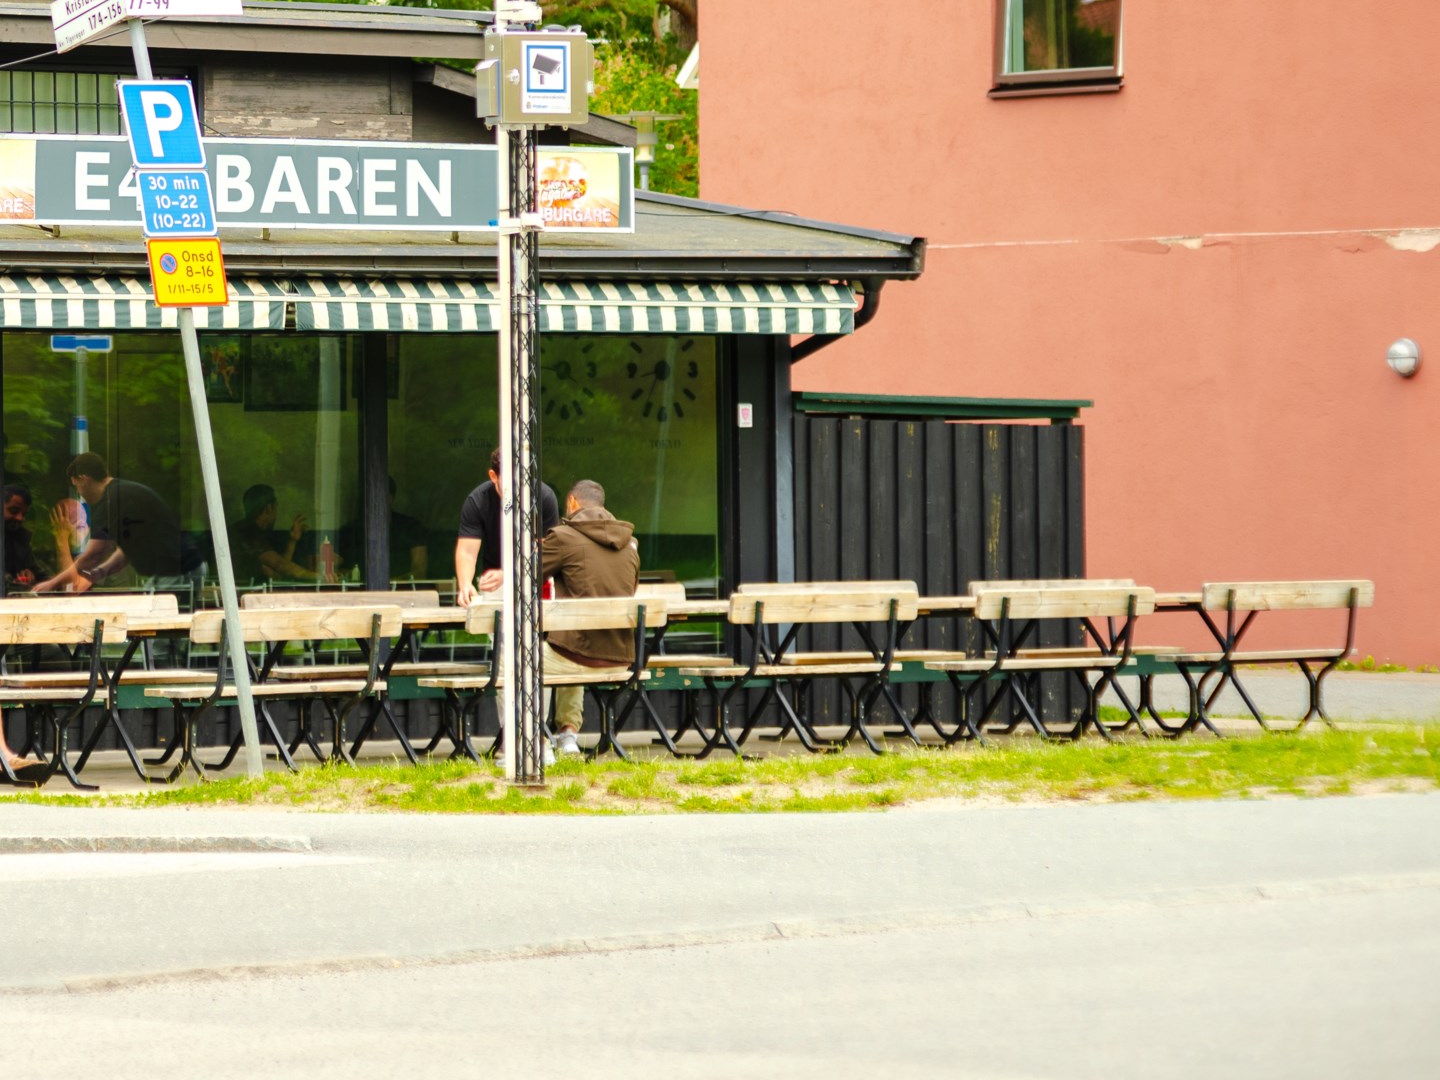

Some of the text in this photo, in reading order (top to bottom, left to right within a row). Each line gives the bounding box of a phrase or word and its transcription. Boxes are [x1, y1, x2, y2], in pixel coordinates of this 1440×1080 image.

[88, 1, 122, 31] 174-156
[140, 90, 183, 158] P
[75, 151, 452, 217] EBAREN
[148, 176, 200, 191] 30 min
[155, 194, 199, 209] 10-22
[153, 212, 206, 230] (10-22)
[542, 208, 612, 223] BURGARE
[182, 250, 214, 263] Onsd
[186, 265, 215, 278] 8-16
